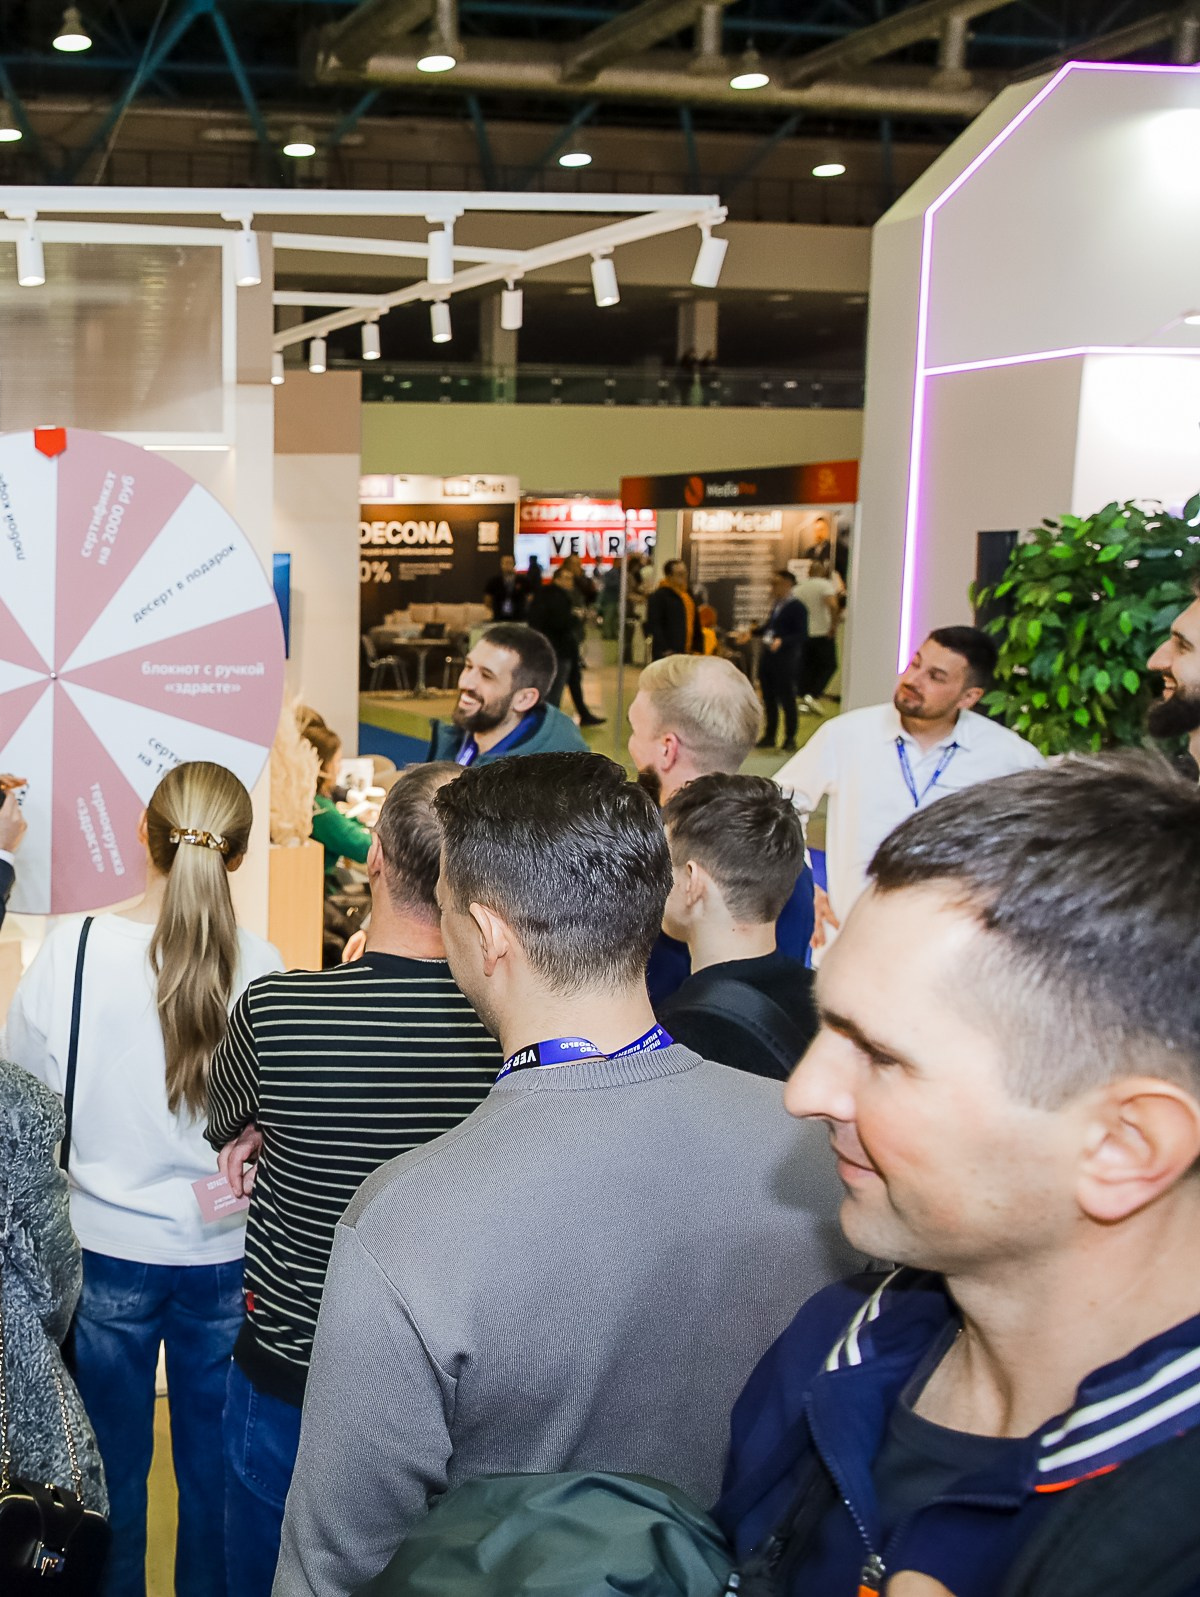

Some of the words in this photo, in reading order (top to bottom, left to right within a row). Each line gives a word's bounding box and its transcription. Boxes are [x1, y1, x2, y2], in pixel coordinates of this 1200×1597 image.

[118, 475, 134, 504] руб
[81, 470, 116, 557] сертификат
[102, 505, 124, 544] 2000
[3, 513, 26, 560] любой
[97, 546, 111, 565] на
[133, 588, 174, 623] десерт
[176, 581, 185, 590] в
[186, 544, 235, 583] подарок
[141, 661, 200, 675] блокнот
[204, 665, 212, 675] с
[215, 662, 265, 679] ручкой
[164, 682, 241, 695] «здрасте»
[137, 752, 152, 767] на
[77, 796, 104, 873] «здрасте»
[90, 782, 125, 876] термокружка
